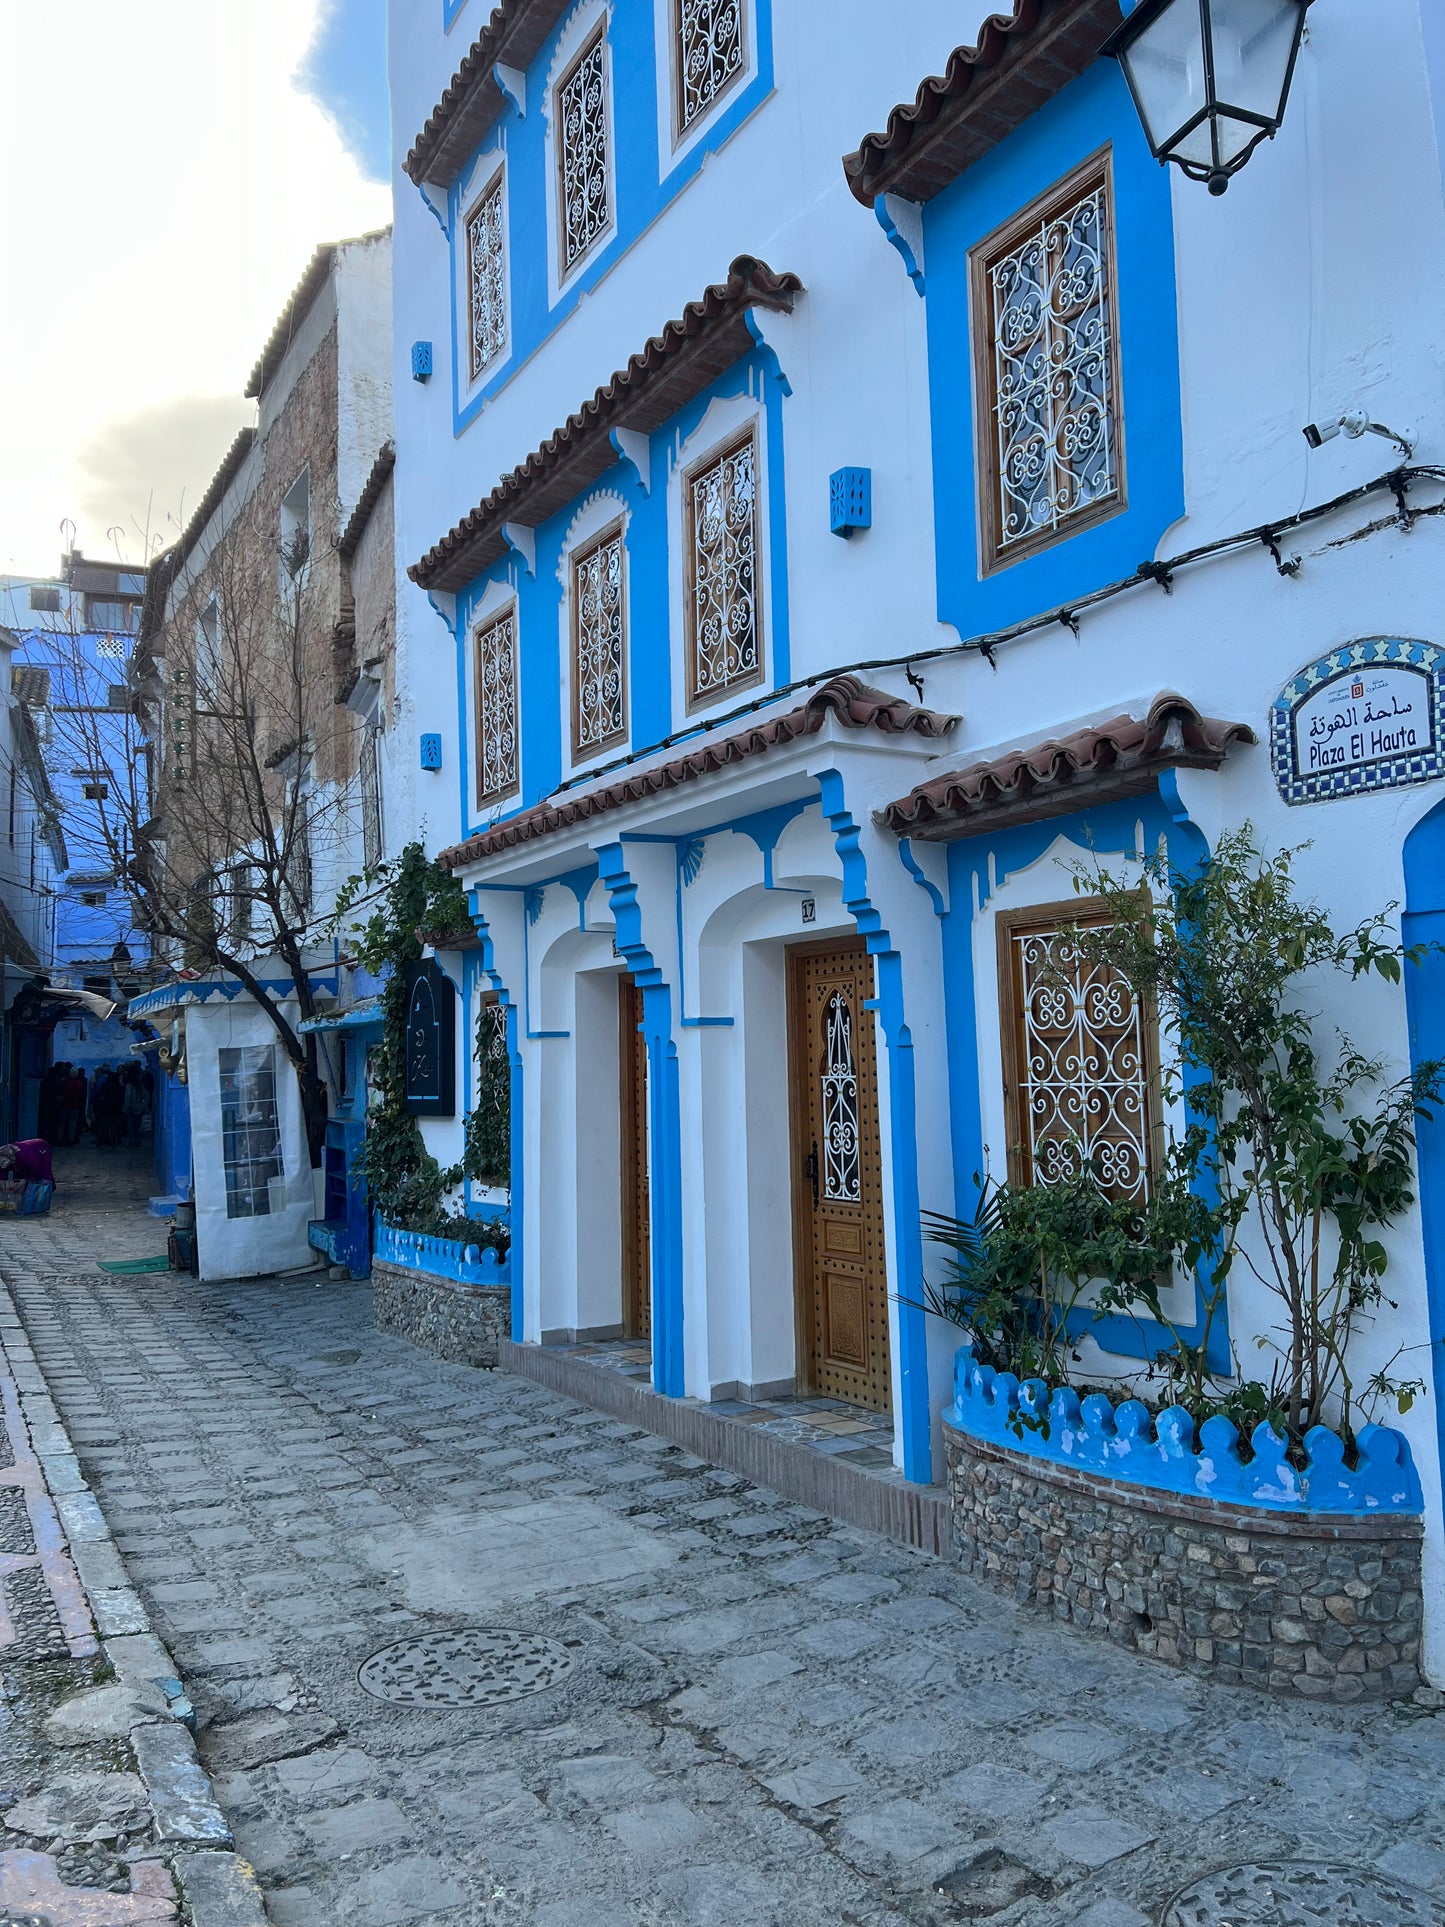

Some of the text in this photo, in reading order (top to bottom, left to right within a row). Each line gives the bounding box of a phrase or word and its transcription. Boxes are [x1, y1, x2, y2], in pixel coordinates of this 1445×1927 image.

[1310, 696, 1412, 745] ساحة الهوتة
[1310, 726, 1416, 768] Plaza El Hauta
[803, 903, 814, 917] 17
